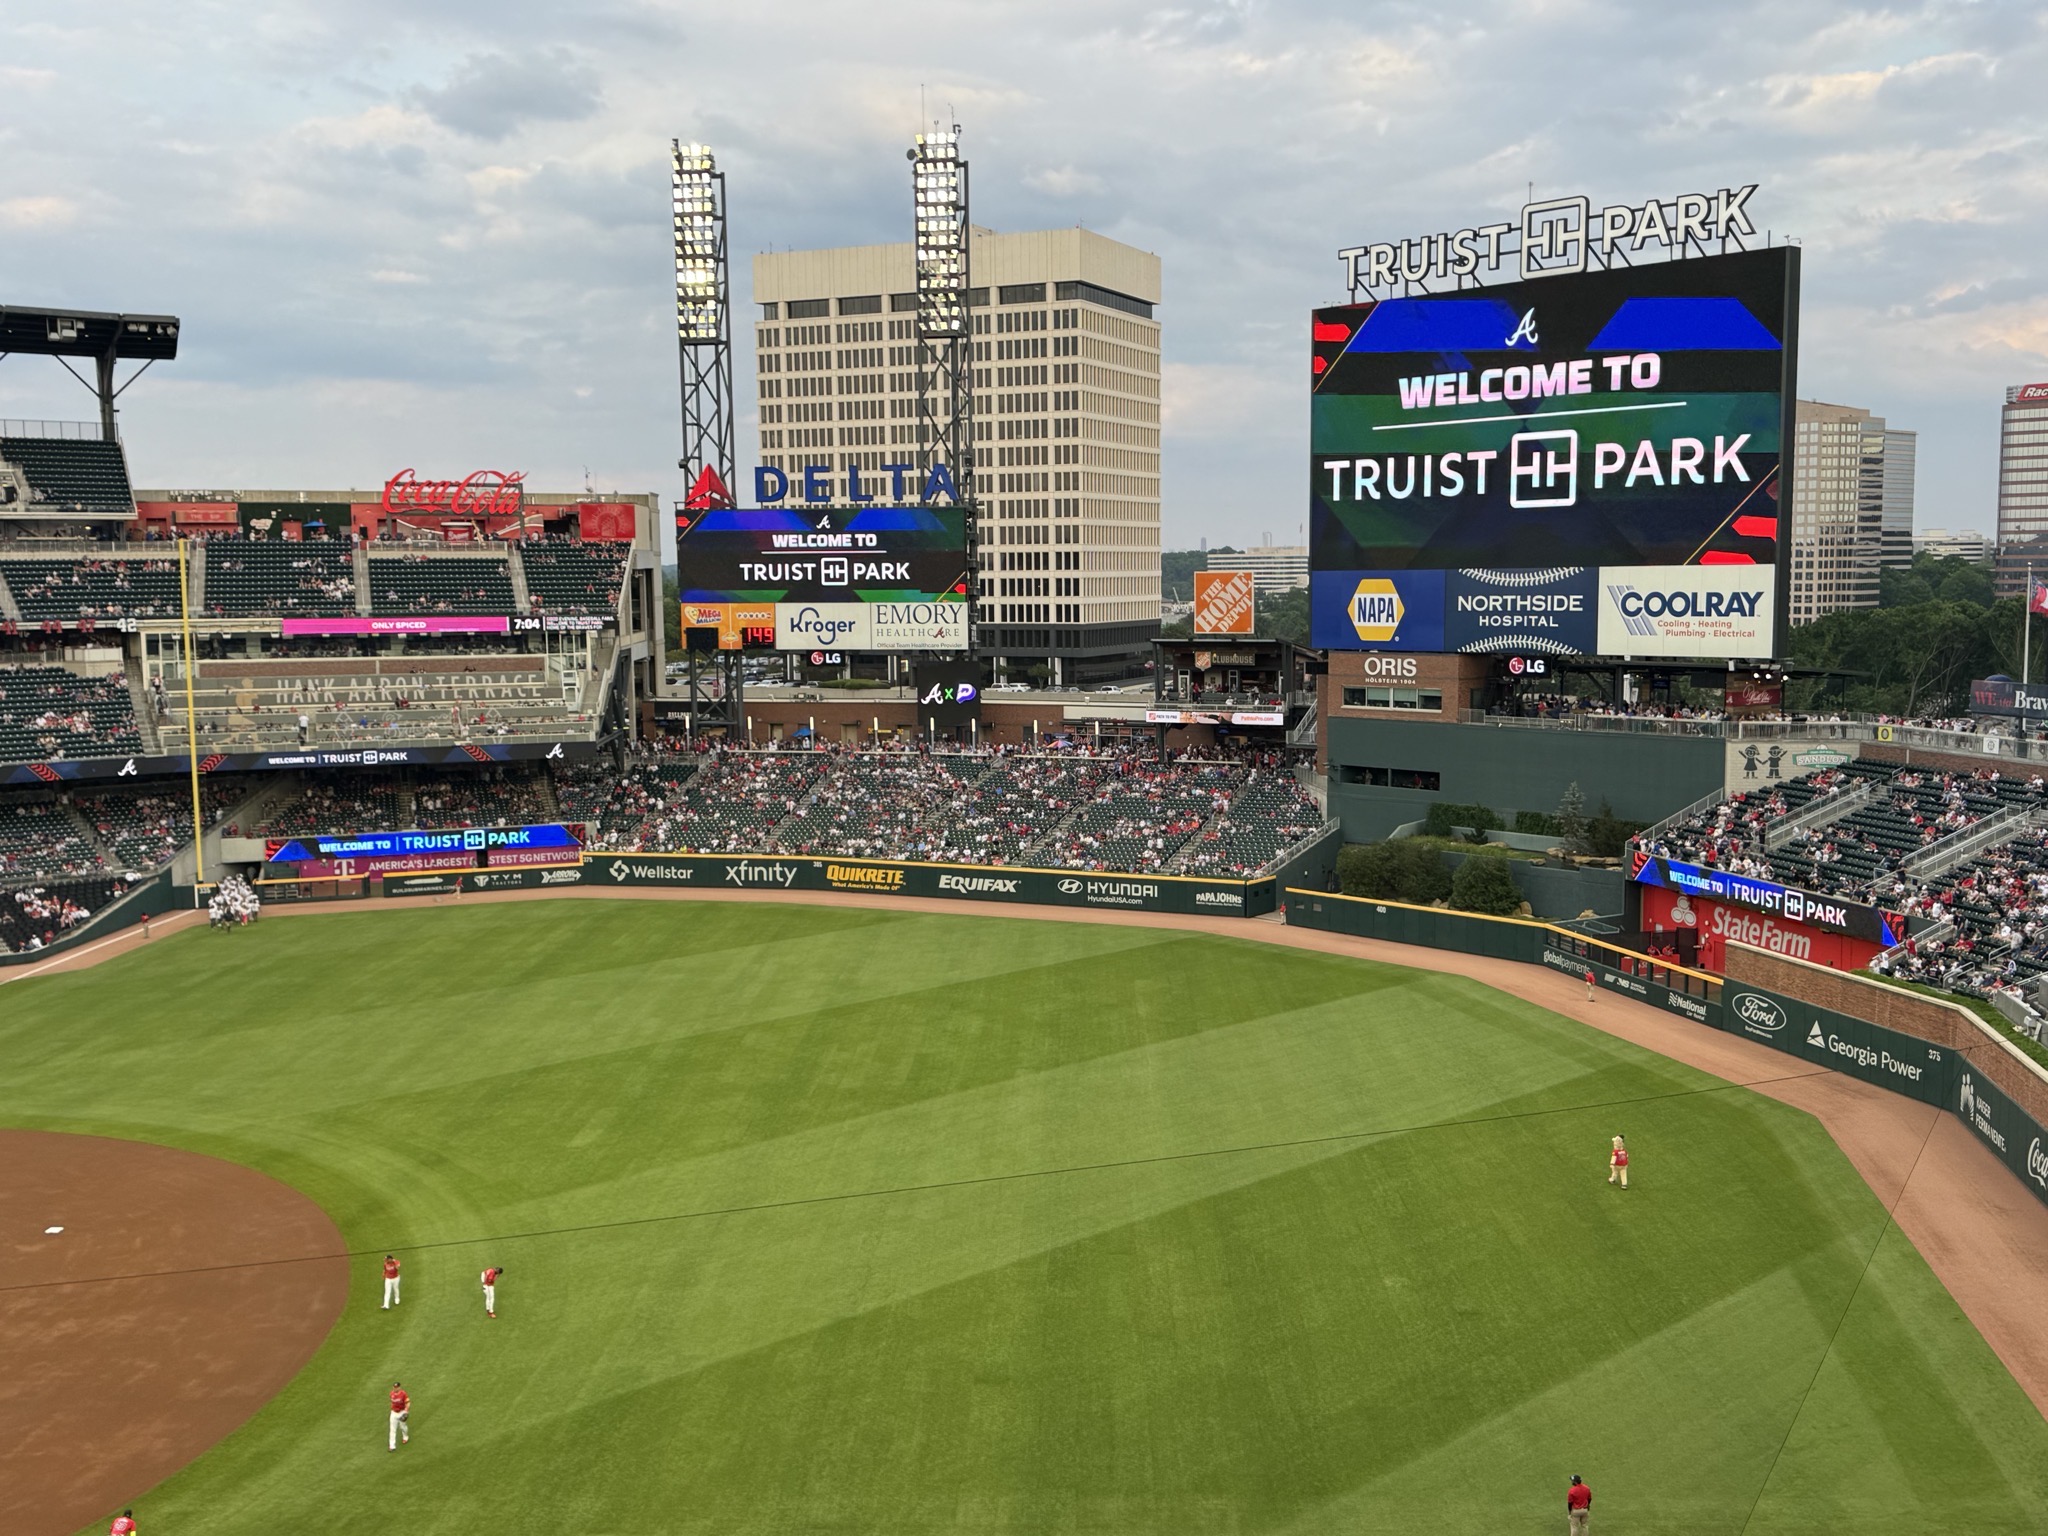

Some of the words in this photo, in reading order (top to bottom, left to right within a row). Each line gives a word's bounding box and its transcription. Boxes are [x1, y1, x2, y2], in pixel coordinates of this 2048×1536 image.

[1338, 222, 1511, 290] TRUIST
[1602, 184, 1759, 254] PARK
[1398, 359, 1592, 410] WELCOME
[1602, 352, 1661, 391] TO
[1323, 450, 1497, 501] TRUIST
[1594, 433, 1752, 489] PARK
[755, 464, 957, 502] DELTA
[772, 533, 852, 548] WELCOME
[855, 533, 877, 546] TO
[739, 563, 816, 581] TRUIST
[853, 562, 910, 580] PARK
[1200, 578, 1224, 604] THE
[1195, 572, 1252, 632] HOME
[1357, 597, 1395, 623] NAPA
[1457, 595, 1584, 613] NORTHSIDE
[1620, 590, 1764, 617] COOLRAY
[697, 608, 721, 618] MEGA
[875, 604, 963, 624] EMORY
[1217, 595, 1252, 633] DEPOT
[1479, 615, 1559, 627] HOSPITAL
[41, 620, 63, 634] 44
[76, 619, 96, 633] 47
[117, 618, 137, 633] 42
[514, 619, 540, 630] 7:04
[790, 607, 856, 645] Kroger
[876, 627, 960, 638] HEALTHCARE
[1657, 620, 1690, 629] Cooling
[1698, 620, 1732, 629] Heating
[1665, 629, 1706, 638] Plumbing
[1713, 630, 1755, 638] Electrical
[747, 627, 774, 643] 149
[825, 652, 841, 664] LG
[1212, 655, 1254, 665] CLUBHOUSE
[1364, 657, 1417, 677] ORIS
[1526, 659, 1545, 673] LG
[277, 677, 335, 704] HANK
[349, 675, 425, 702] AARON
[436, 673, 542, 700] TERRACE
[1975, 691, 1997, 706] WE
[268, 756, 304, 765] WELCOME
[304, 756, 316, 764] TO
[322, 753, 362, 764] TRUIST
[379, 752, 408, 761] PARK
[319, 841, 376, 853] WELCOME
[376, 840, 391, 850] TO
[402, 834, 462, 849] TRUIST
[488, 831, 530, 845] PARK
[368, 858, 423, 871] AMERICA'S
[424, 857, 467, 868] LARGEST
[519, 853, 533, 864] 5G
[631, 864, 693, 880] Wellstar
[725, 860, 798, 887] xfinity
[826, 864, 904, 885] QUIKRETE
[938, 874, 1018, 894] EQUIFAX
[1087, 881, 1158, 898] HYUNDAI
[1087, 895, 1143, 905] HyundaiUSA.com
[1195, 892, 1215, 902] PAPA
[1216, 892, 1242, 903] JOHNS
[1669, 869, 1711, 891] WELCOME
[1710, 881, 1724, 893] TO
[1732, 882, 1783, 910] TRUIST
[1806, 903, 1847, 927] PARK
[1677, 997, 1707, 1016] National
[1741, 996, 1777, 1027] Ford
[1828, 1034, 1877, 1067] Georgia
[1881, 1051, 1923, 1082] Power
[1928, 1049, 1941, 1062] 375
[1976, 1095, 1992, 1120] KAISER
[1975, 1113, 2006, 1153] PERMANENTE
